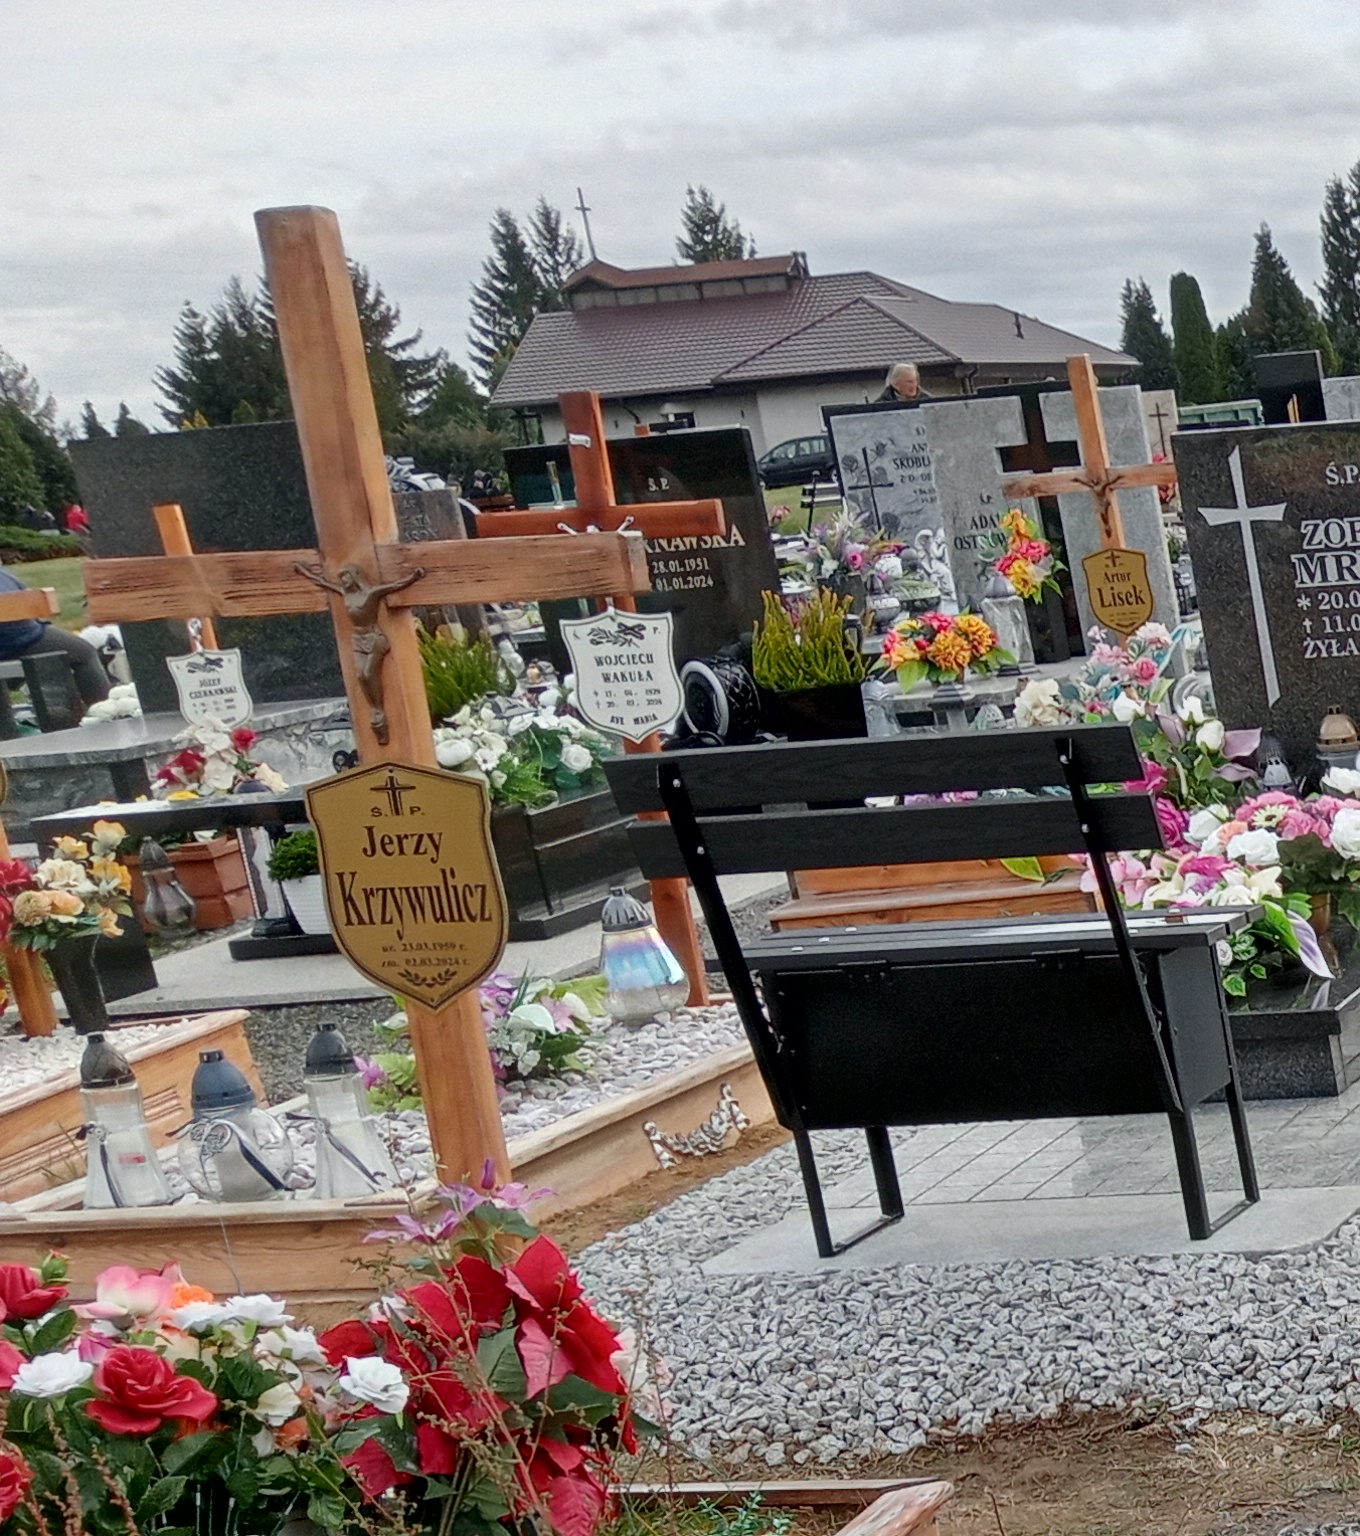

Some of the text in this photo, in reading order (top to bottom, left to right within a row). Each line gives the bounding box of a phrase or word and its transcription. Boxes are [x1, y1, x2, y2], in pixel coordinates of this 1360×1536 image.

[655, 574, 714, 592] 01.01.2024
[1103, 571, 1132, 585] Artur
[1097, 584, 1146, 608] Lisek
[1303, 636, 1360, 659] ŻYŁA
[594, 653, 655, 667] WOJCIECH
[361, 825, 443, 864] Jerzy
[335, 866, 493, 941] Krzywulicz
